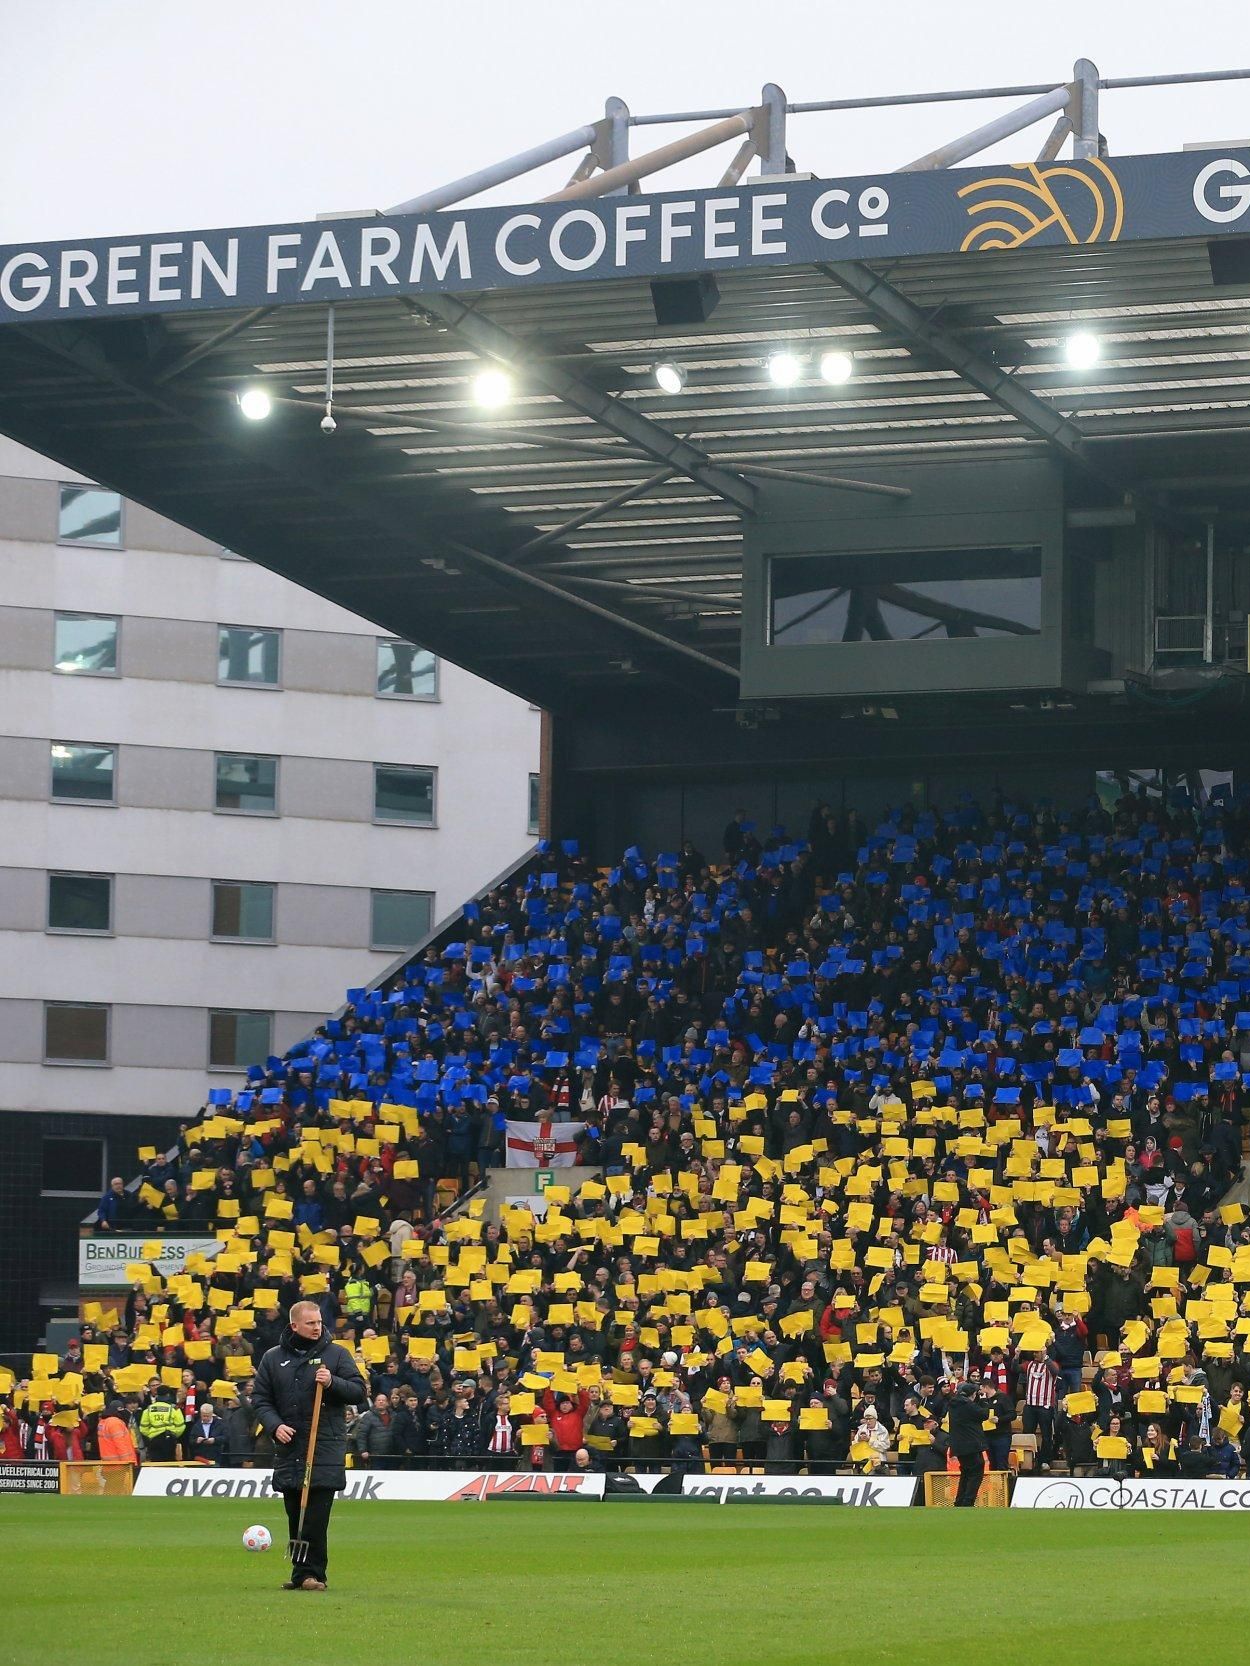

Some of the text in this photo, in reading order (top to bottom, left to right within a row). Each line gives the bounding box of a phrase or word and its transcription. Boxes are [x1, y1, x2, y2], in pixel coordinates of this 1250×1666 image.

[0, 238, 238, 312] GREEN
[266, 220, 472, 294] FARM
[495, 193, 788, 276] COFFEE
[537, 1173, 551, 1190] F
[0, 1478, 59, 1489] SERVICES SINCE 2001
[165, 1474, 385, 1500] avant.uk
[1089, 1487, 1216, 1509] COASTAL
